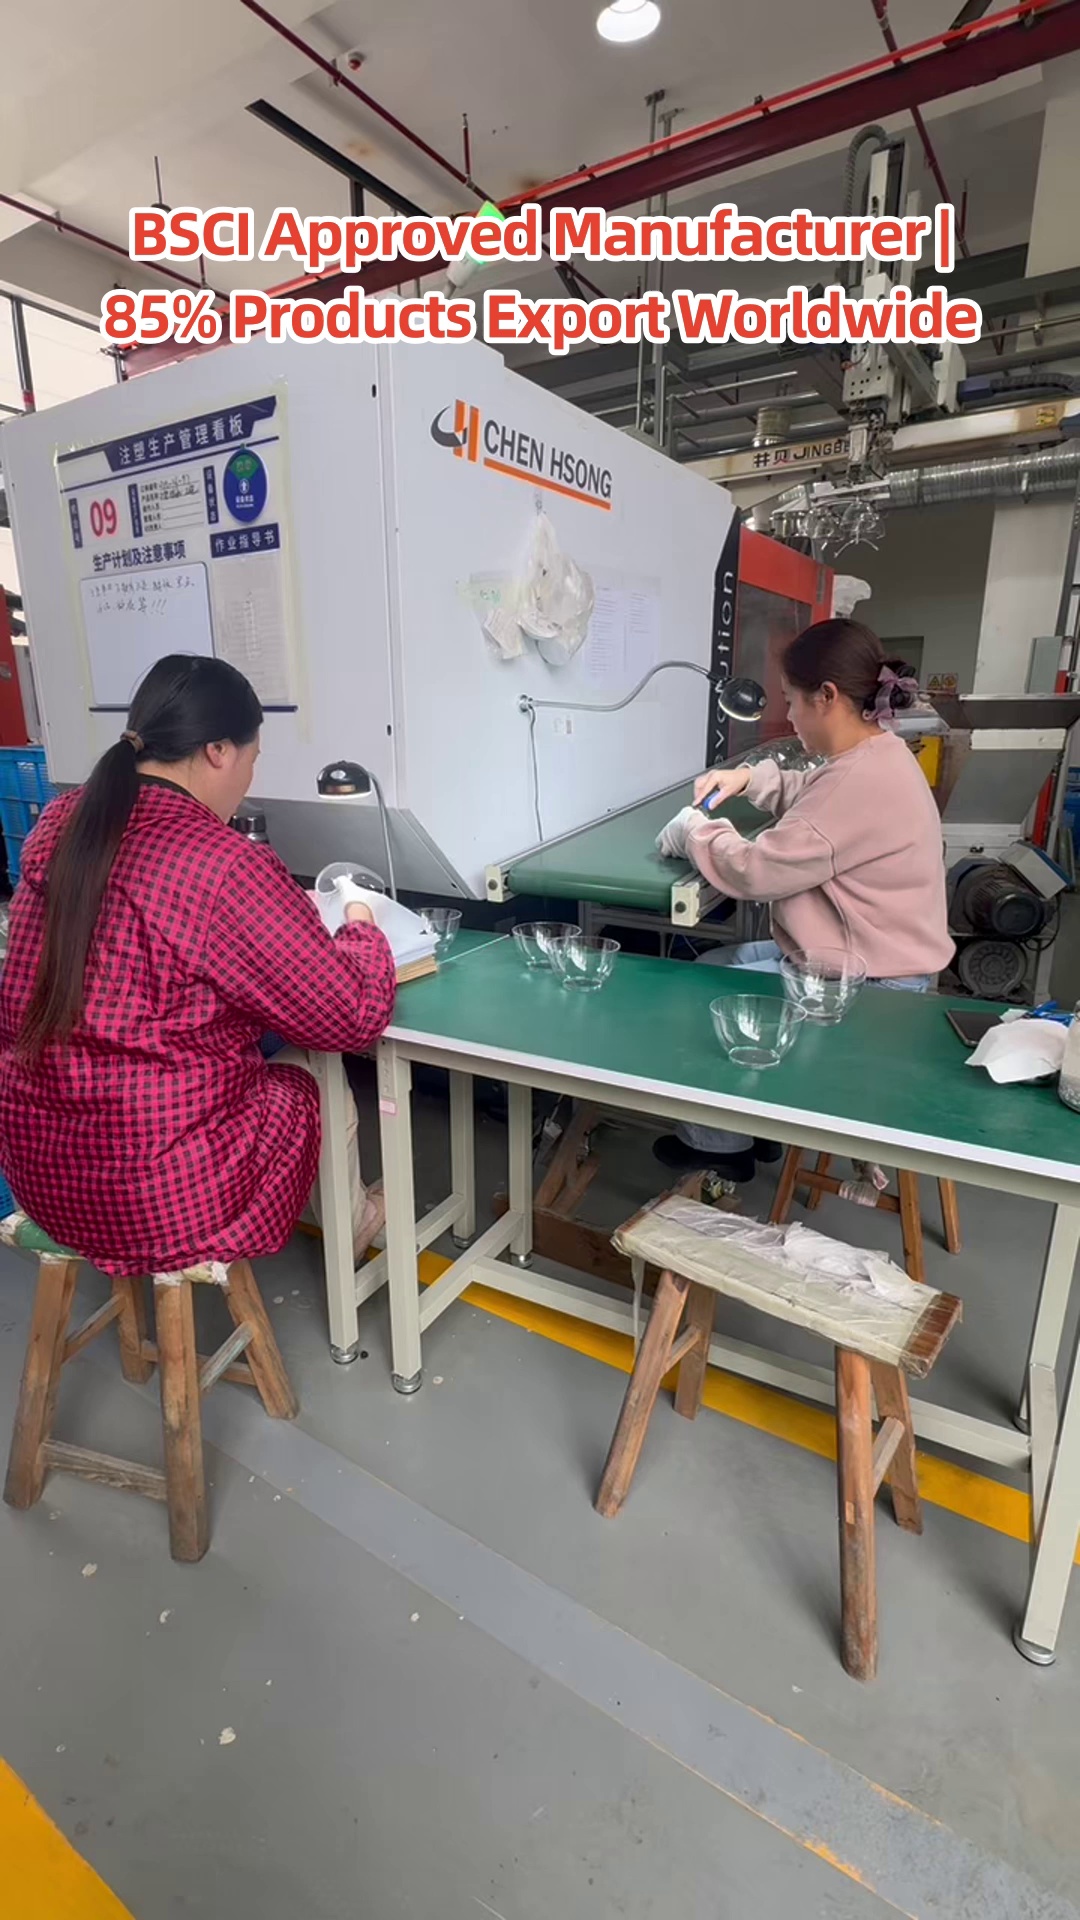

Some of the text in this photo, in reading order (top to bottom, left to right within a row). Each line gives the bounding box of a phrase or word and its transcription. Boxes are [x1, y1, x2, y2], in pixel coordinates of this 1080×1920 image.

[118, 413, 245, 466] 注塑生产管理看板
[484, 419, 613, 499] CHEN HSONG
[90, 498, 117, 537] 09
[92, 539, 187, 572] 生产计划及注意事项
[215, 529, 276, 553] 作业指导书
